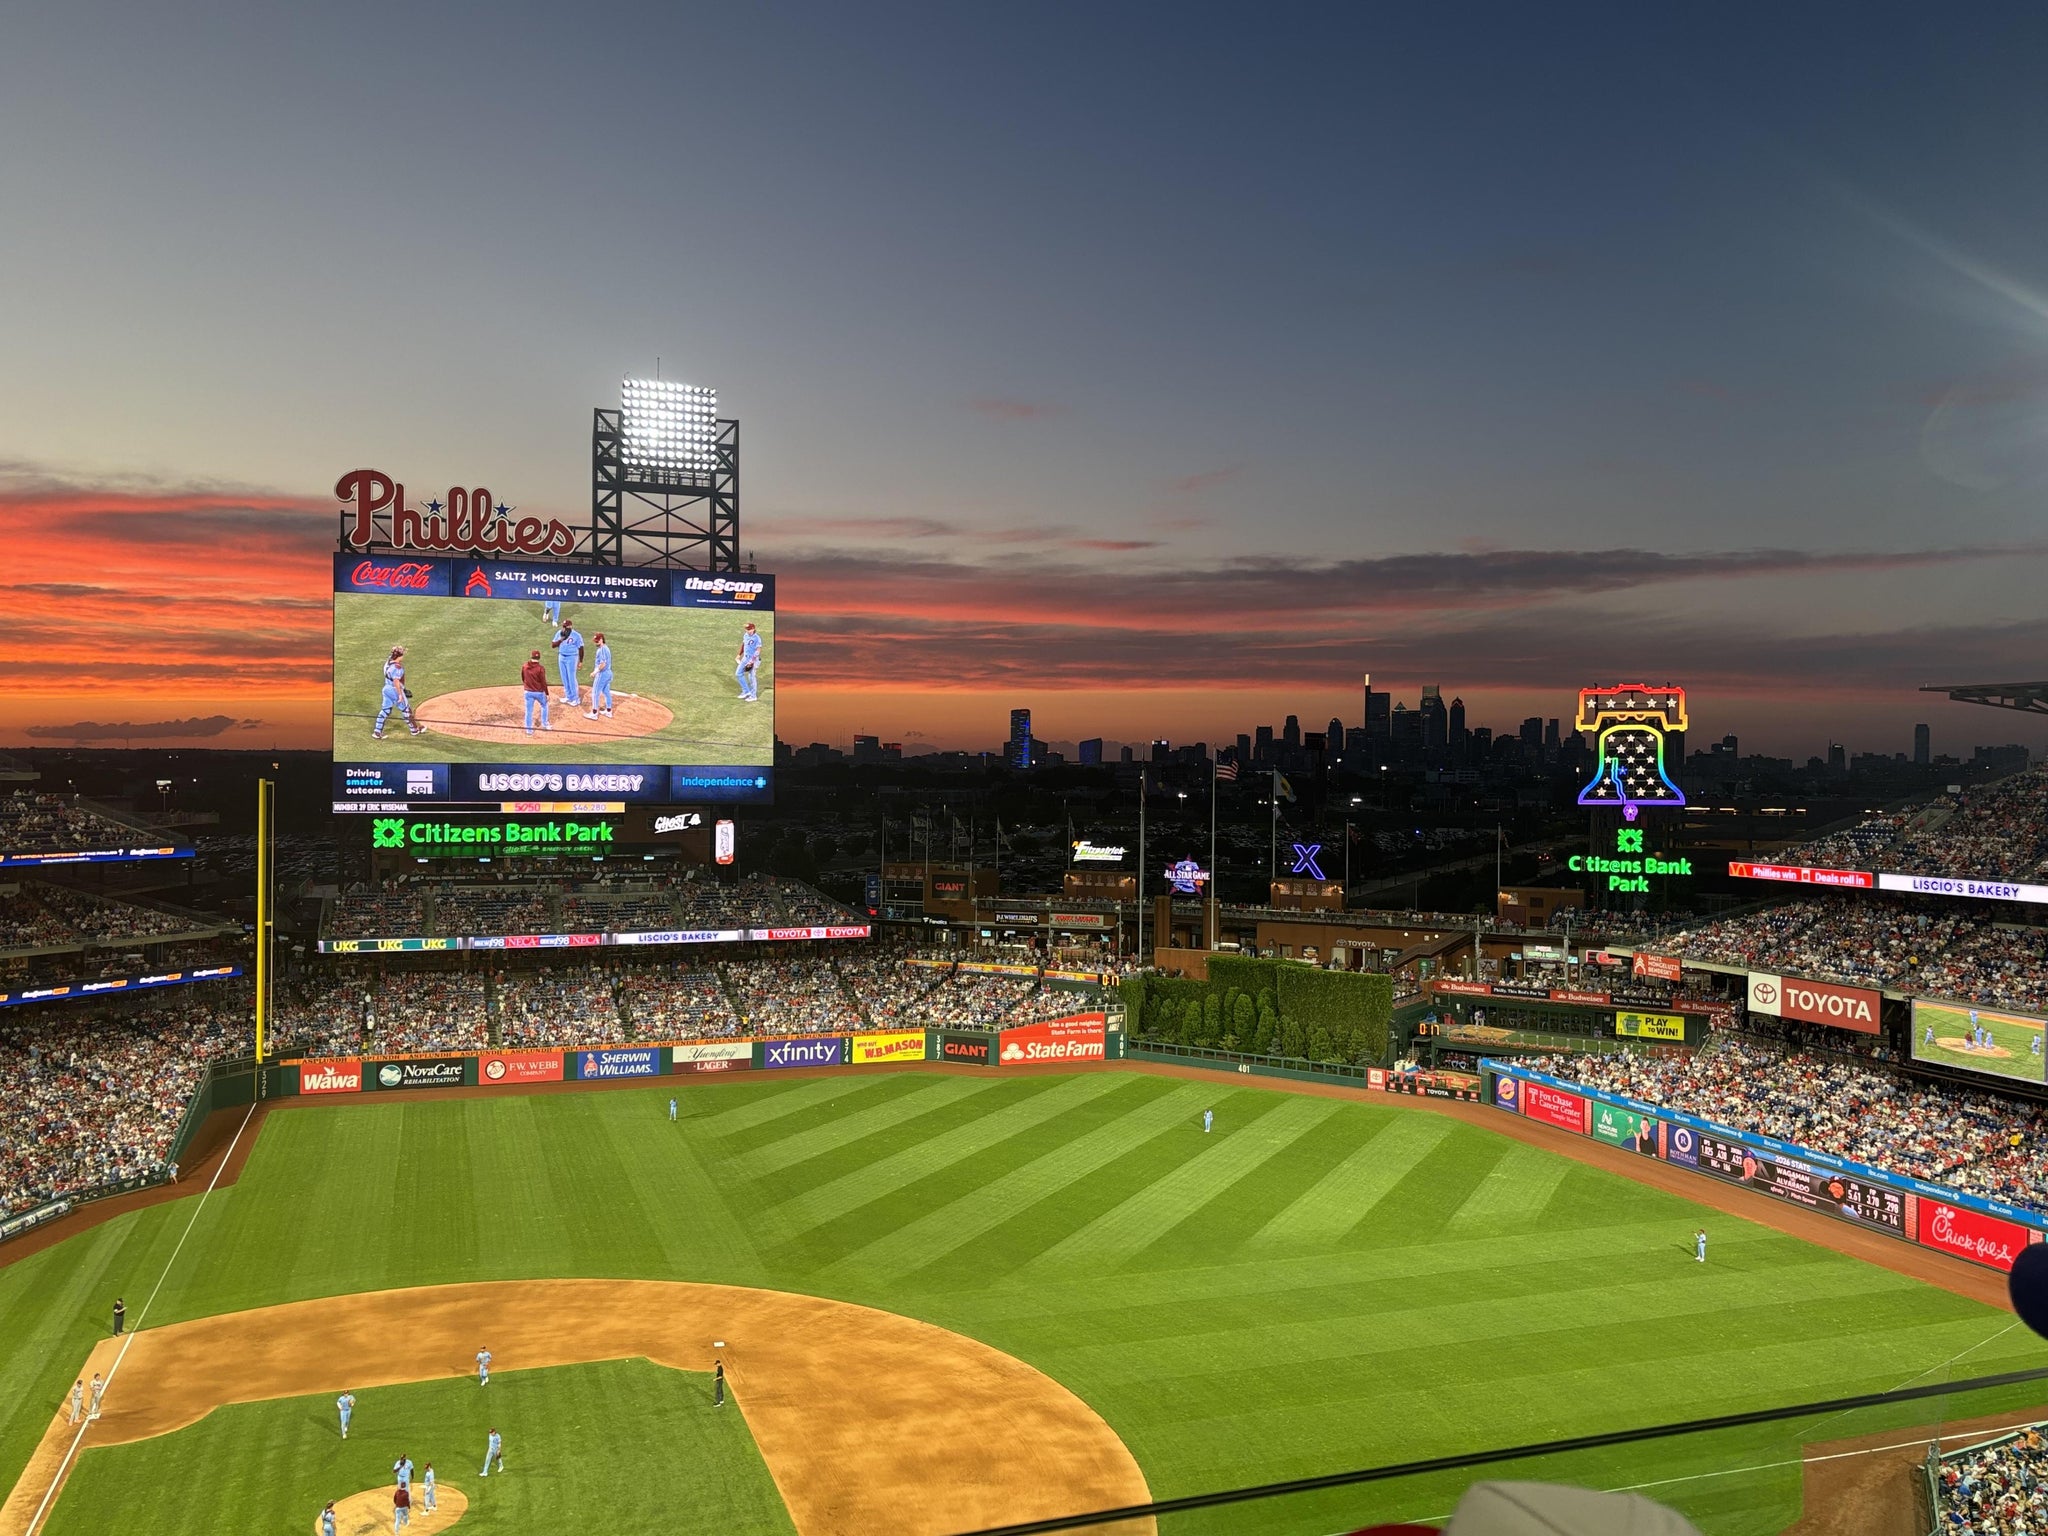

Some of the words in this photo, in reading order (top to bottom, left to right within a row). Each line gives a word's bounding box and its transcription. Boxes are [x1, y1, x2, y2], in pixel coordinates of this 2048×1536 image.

[334, 469, 575, 556] Phillies
[495, 572, 527, 582] SALTZ
[531, 574, 600, 585] MONGELUZZI
[605, 577, 658, 588] BENDESKY
[685, 577, 764, 593] theScore
[528, 588, 569, 596] INJURY
[578, 590, 628, 599] LAWYERS
[346, 769, 381, 779] Driving
[479, 773, 563, 792] LISCIO'S
[566, 774, 643, 792] BAKERY
[682, 776, 753, 789] Independence
[334, 803, 358, 811] NUMBER
[655, 813, 691, 834] GHOST
[410, 823, 501, 843] Citizens
[506, 822, 561, 843] Bank
[566, 822, 613, 842] Park
[1568, 855, 1641, 873] Citizens
[1645, 857, 1693, 876] Bank
[1193, 871, 1210, 880] GAME
[1753, 867, 1782, 880] Phillies
[1783, 870, 1797, 881] win
[1815, 872, 1839, 884] Deals
[1840, 874, 1854, 885] roll
[1856, 875, 1865, 885] in
[935, 883, 965, 891] GIANT
[1609, 876, 1650, 893] Park
[1913, 879, 1964, 894] LISCIO'S
[1968, 884, 2020, 898] BAKERY
[638, 933, 679, 942] LISCIO'S
[681, 932, 719, 941] BAKERY
[772, 929, 808, 939] TOYOTA
[829, 928, 865, 937] TOYOTA
[333, 941, 359, 952] UKG
[378, 940, 403, 951] UKG
[422, 939, 447, 950] UKG
[1348, 940, 1376, 948] TOYOTA
[1451, 985, 1485, 993] Budweiser
[1568, 992, 1604, 1003] Budweiser
[1786, 988, 1872, 1023] TOYOTA
[1645, 1017, 1668, 1026] PLAY
[1656, 1027, 1678, 1036] WIN!
[408, 1052, 452, 1060] ASPLUNDH
[688, 1046, 737, 1061] Yuengling
[769, 1042, 836, 1065] xfinity
[944, 1043, 988, 1058] GIANT
[601, 1053, 651, 1064] SHERWIN
[403, 1064, 462, 1077] NovaCare
[510, 1063, 526, 1071] F.W.
[529, 1061, 558, 1069] WEBB
[696, 1061, 729, 1070] LAGER
[1238, 1064, 1250, 1074] 401
[304, 1074, 358, 1090] Wawa
[403, 1076, 460, 1085] REHABILITATION
[1540, 1092, 1551, 1100] Fox
[1552, 1095, 1573, 1108] Chase
[1539, 1100, 1559, 1111] Cancer
[1560, 1106, 1581, 1118] Center
[1680, 1136, 1687, 1145] R
[1791, 1160, 1812, 1172] STATS
[1777, 1177, 1810, 1193] ALVARADO
[1805, 1151, 1837, 1165] Independence
[1868, 1169, 1889, 1180] ibx.com
[1915, 1183, 1952, 1198] Independence
[1989, 1203, 2013, 1216] ibx.com
[1851, 1183, 1859, 1191] ERA
[1848, 1190, 1861, 1202] 5.61
[1858, 1205, 1862, 1215] 5
[1874, 1210, 1878, 1220] 9
[1890, 1215, 1898, 1226] 14
[1932, 1208, 2014, 1263] Chick-fil-A
